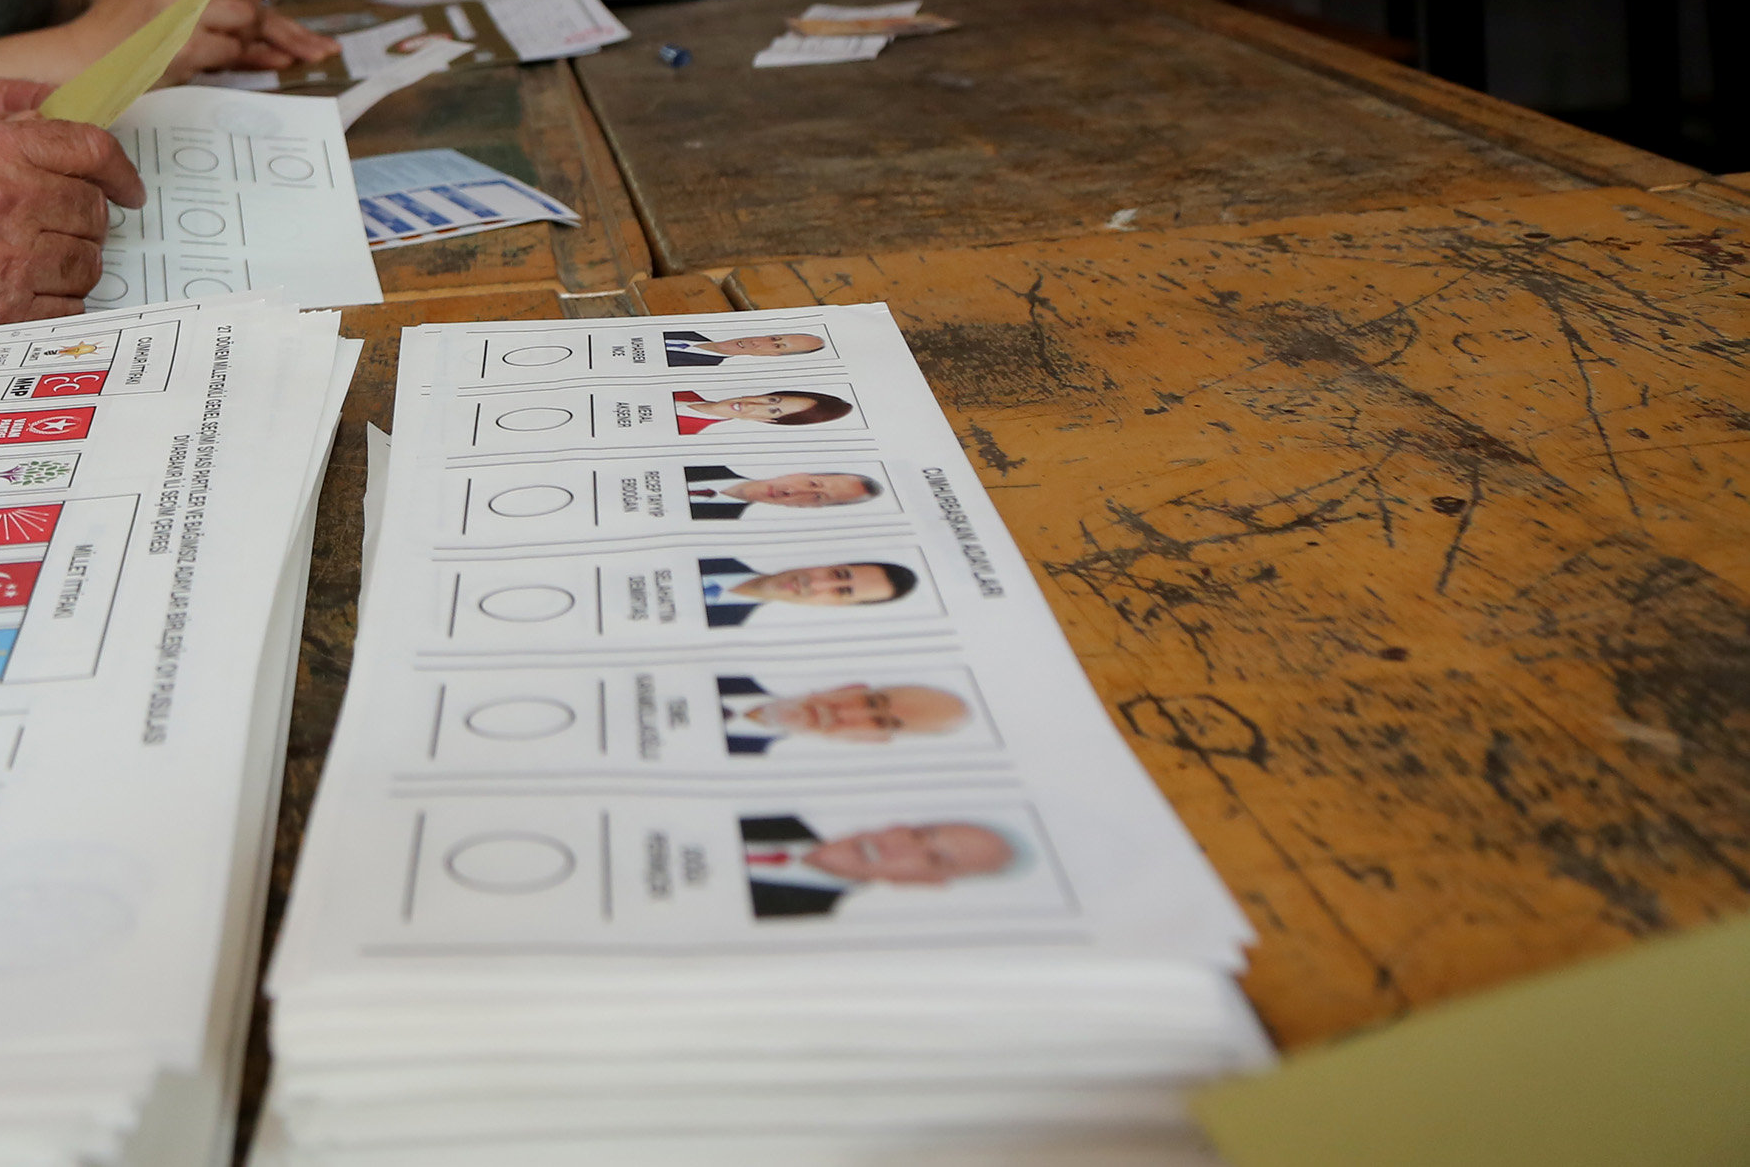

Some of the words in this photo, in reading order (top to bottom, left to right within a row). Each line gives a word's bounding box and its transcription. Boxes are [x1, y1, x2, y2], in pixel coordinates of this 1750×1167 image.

[132, 337, 153, 364] CUMHUR
[213, 336, 234, 361] DÖNEM
[611, 346, 627, 357] İNCE
[630, 337, 646, 365] MUHARREM
[9, 378, 36, 397] MHP
[124, 364, 149, 386] İTTİFAKI
[206, 361, 231, 399] MİLLETVEKİLİ
[202, 399, 222, 423] GENEL
[612, 402, 631, 429] AKŞENER
[637, 404, 653, 425] MERAL
[7, 418, 27, 439] VATAN
[195, 422, 220, 446] SEÇİMİ
[166, 434, 193, 479] DİYARBAKIR
[194, 446, 218, 470] SİYASİ
[162, 478, 185, 490] İLİ
[188, 470, 212, 509] PARTİLER
[644, 471, 662, 493] RECEP
[154, 490, 182, 518] SEÇİM
[620, 478, 642, 513] ERDOĞAN
[646, 494, 667, 519] TAYYİP
[184, 508, 204, 521] VE
[148, 519, 173, 555] ÇEVRESİ
[176, 522, 205, 564] BAĞIMSIZ
[66, 544, 95, 577] MİLLET
[52, 578, 89, 621] İTTİFAKI
[169, 567, 195, 610] ADAYLAR
